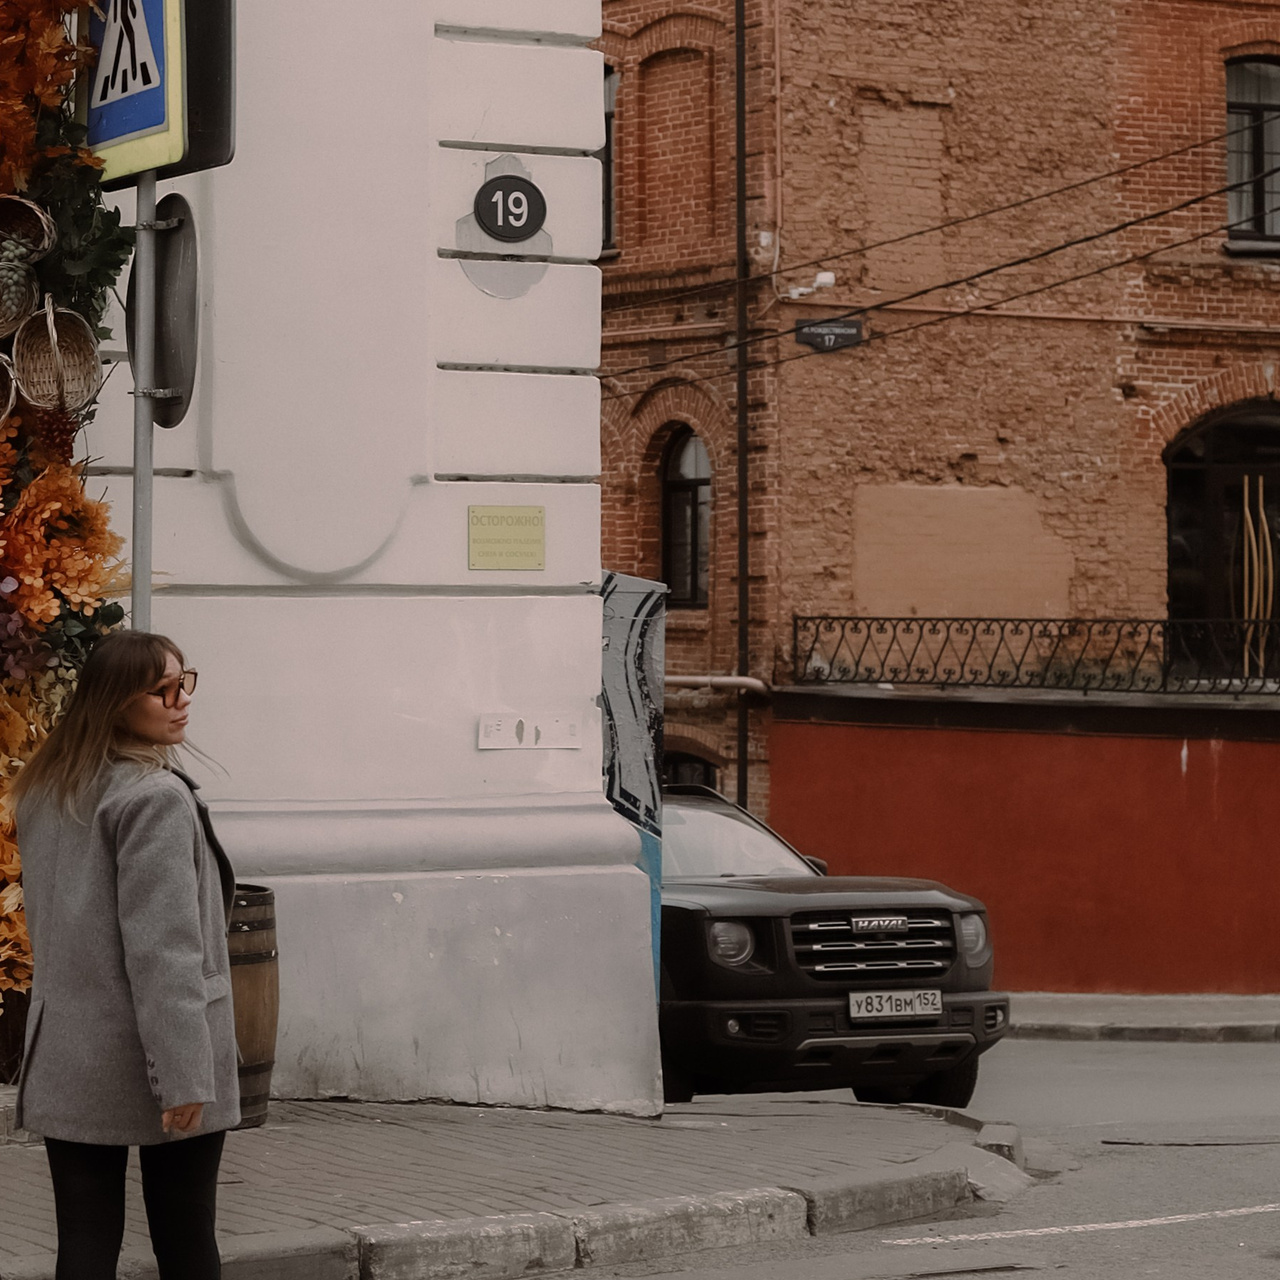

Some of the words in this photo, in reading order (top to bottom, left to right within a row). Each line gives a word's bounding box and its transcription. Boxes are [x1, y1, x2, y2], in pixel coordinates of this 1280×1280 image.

[491, 190, 529, 228] 19
[824, 335, 836, 347] 17
[470, 515, 544, 527] ОСТОРОЖНО!
[857, 920, 906, 930] HAVAL
[855, 994, 914, 1014] У831ВМ
[915, 992, 937, 1007] 152
